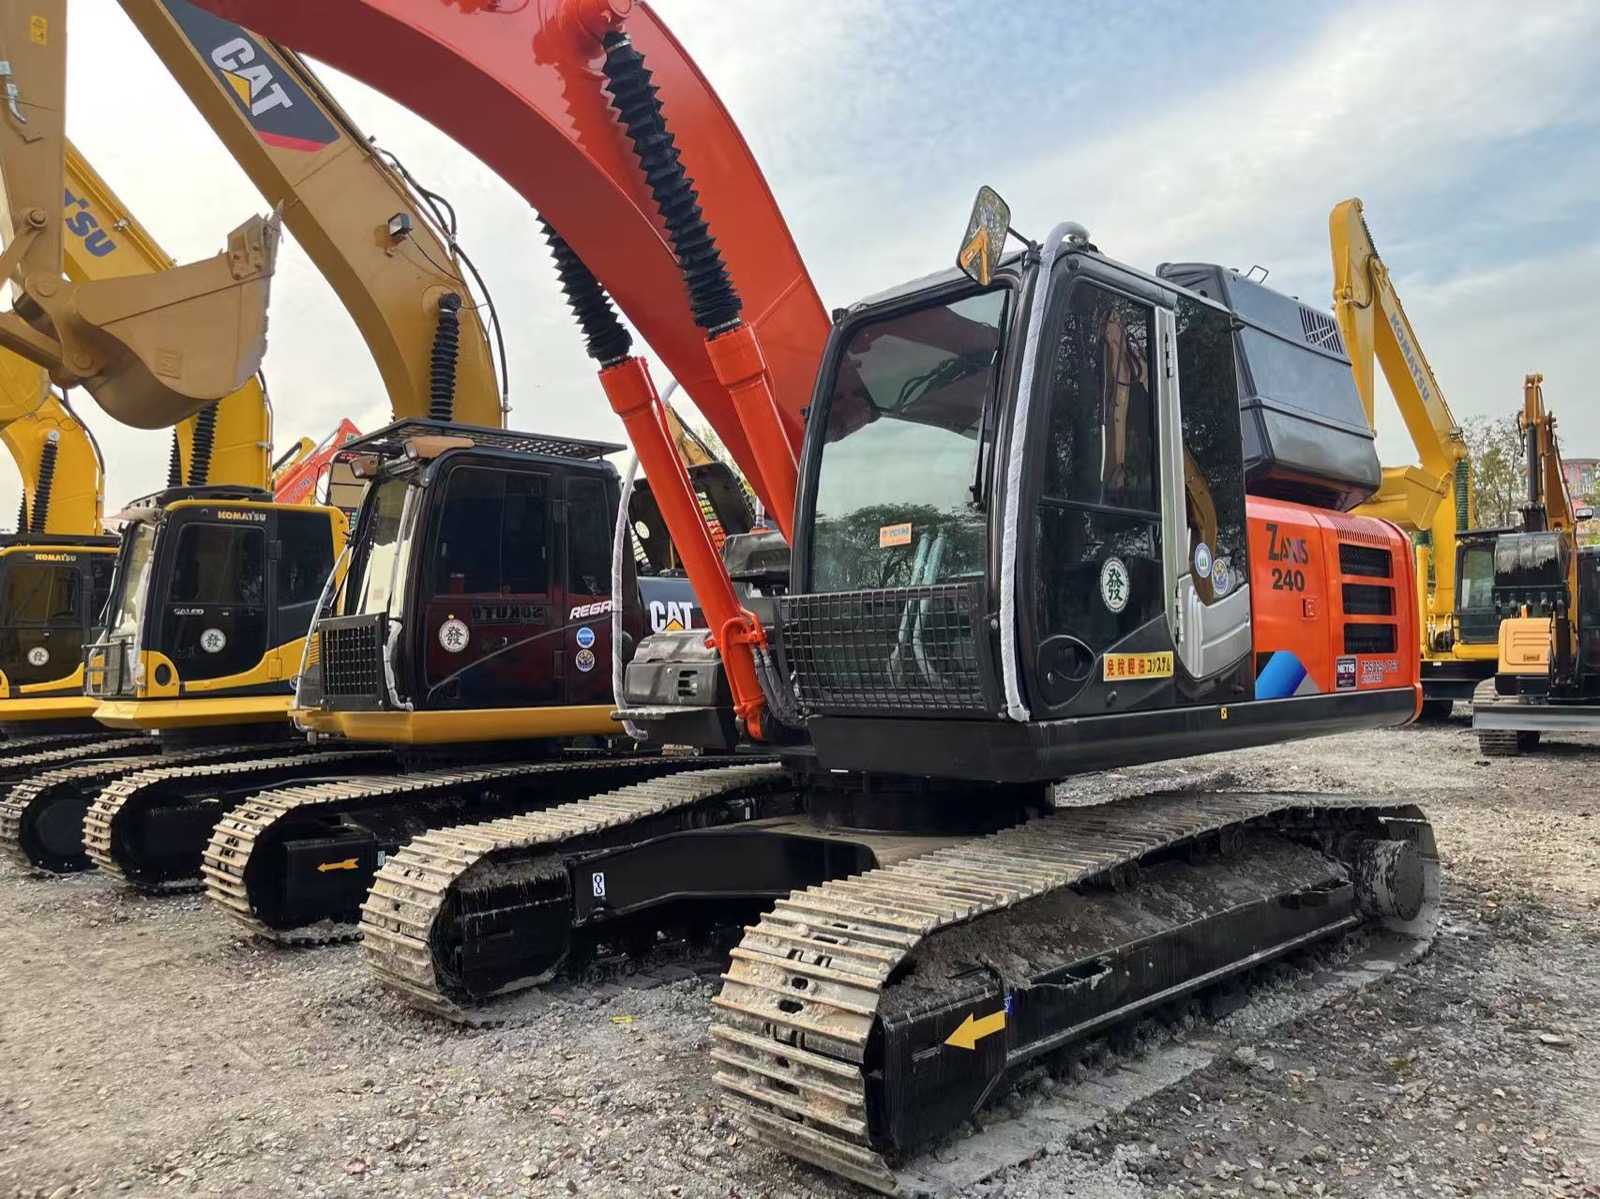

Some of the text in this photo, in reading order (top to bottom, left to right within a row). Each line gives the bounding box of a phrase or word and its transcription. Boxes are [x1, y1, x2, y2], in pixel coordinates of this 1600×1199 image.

[212, 37, 293, 117] CAT
[1391, 312, 1430, 401] KOMATSU
[217, 510, 266, 522] KOMATSU
[35, 553, 77, 562] KOMATSU
[1266, 523, 1309, 566] ZAXIS
[1106, 567, 1125, 602] 發
[1271, 567, 1306, 593] 240
[569, 600, 613, 620] REGA
[650, 600, 694, 633] CAT
[1337, 663, 1355, 674] NETIS
